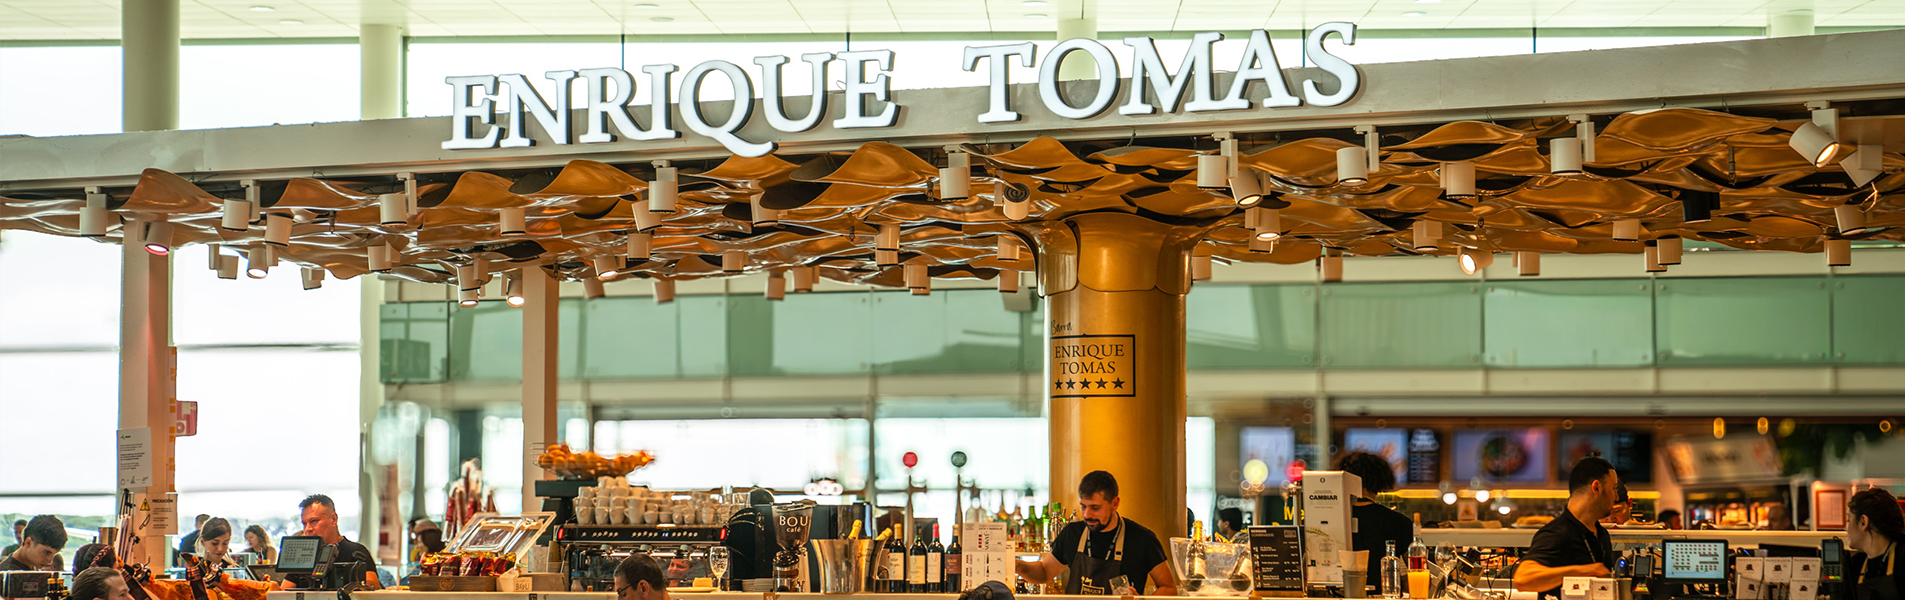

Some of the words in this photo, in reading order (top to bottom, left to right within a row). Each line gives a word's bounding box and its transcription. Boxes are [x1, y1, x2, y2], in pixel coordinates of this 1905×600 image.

[441, 49, 901, 158] ENRIQUE
[962, 22, 1360, 123] TOMAS
[1050, 319, 1073, 335] Barra
[1054, 344, 1125, 360] ENRIQUE
[1060, 361, 1116, 375] TOMAS
[779, 515, 809, 527] BOU
[515, 583, 530, 591] BOU
